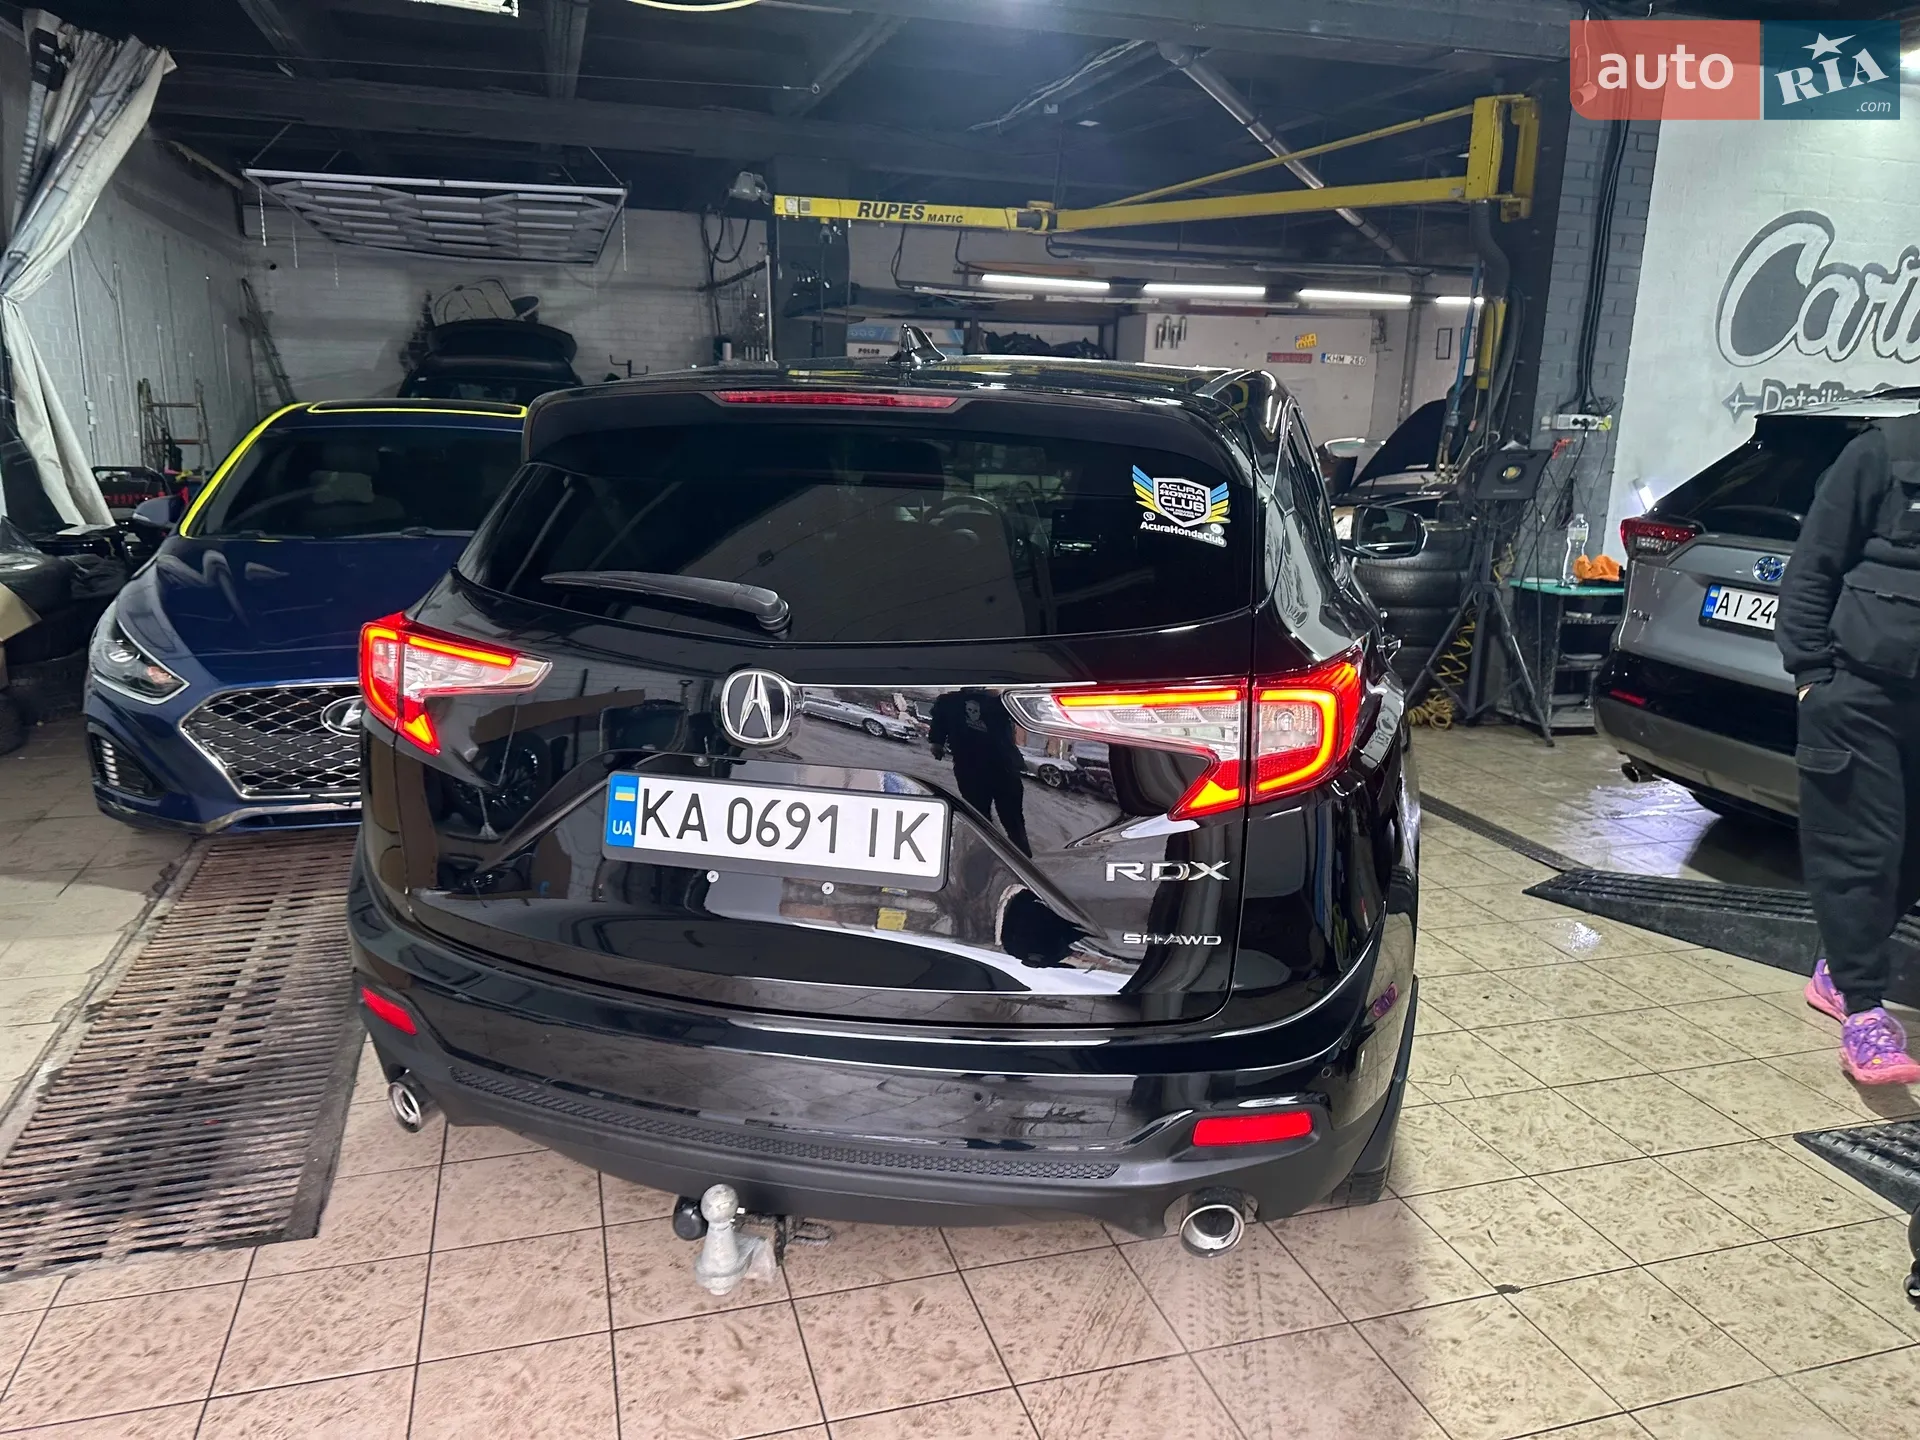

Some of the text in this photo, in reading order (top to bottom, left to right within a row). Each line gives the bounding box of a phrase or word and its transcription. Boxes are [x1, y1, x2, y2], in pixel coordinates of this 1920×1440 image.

[857, 201, 964, 224] RUPES MATIC
[1762, 384, 1850, 413] Detaili
[1159, 482, 1205, 497] ACURA
[1159, 489, 1205, 503] HONDA
[1160, 496, 1205, 513] CLUB
[1140, 521, 1226, 546] AcuraHondaClub
[1705, 604, 1714, 613] UA
[1715, 592, 1776, 624] AI 24
[612, 819, 633, 837] UA
[640, 788, 930, 863] KA 0691 IK
[1105, 860, 1231, 882] RDX
